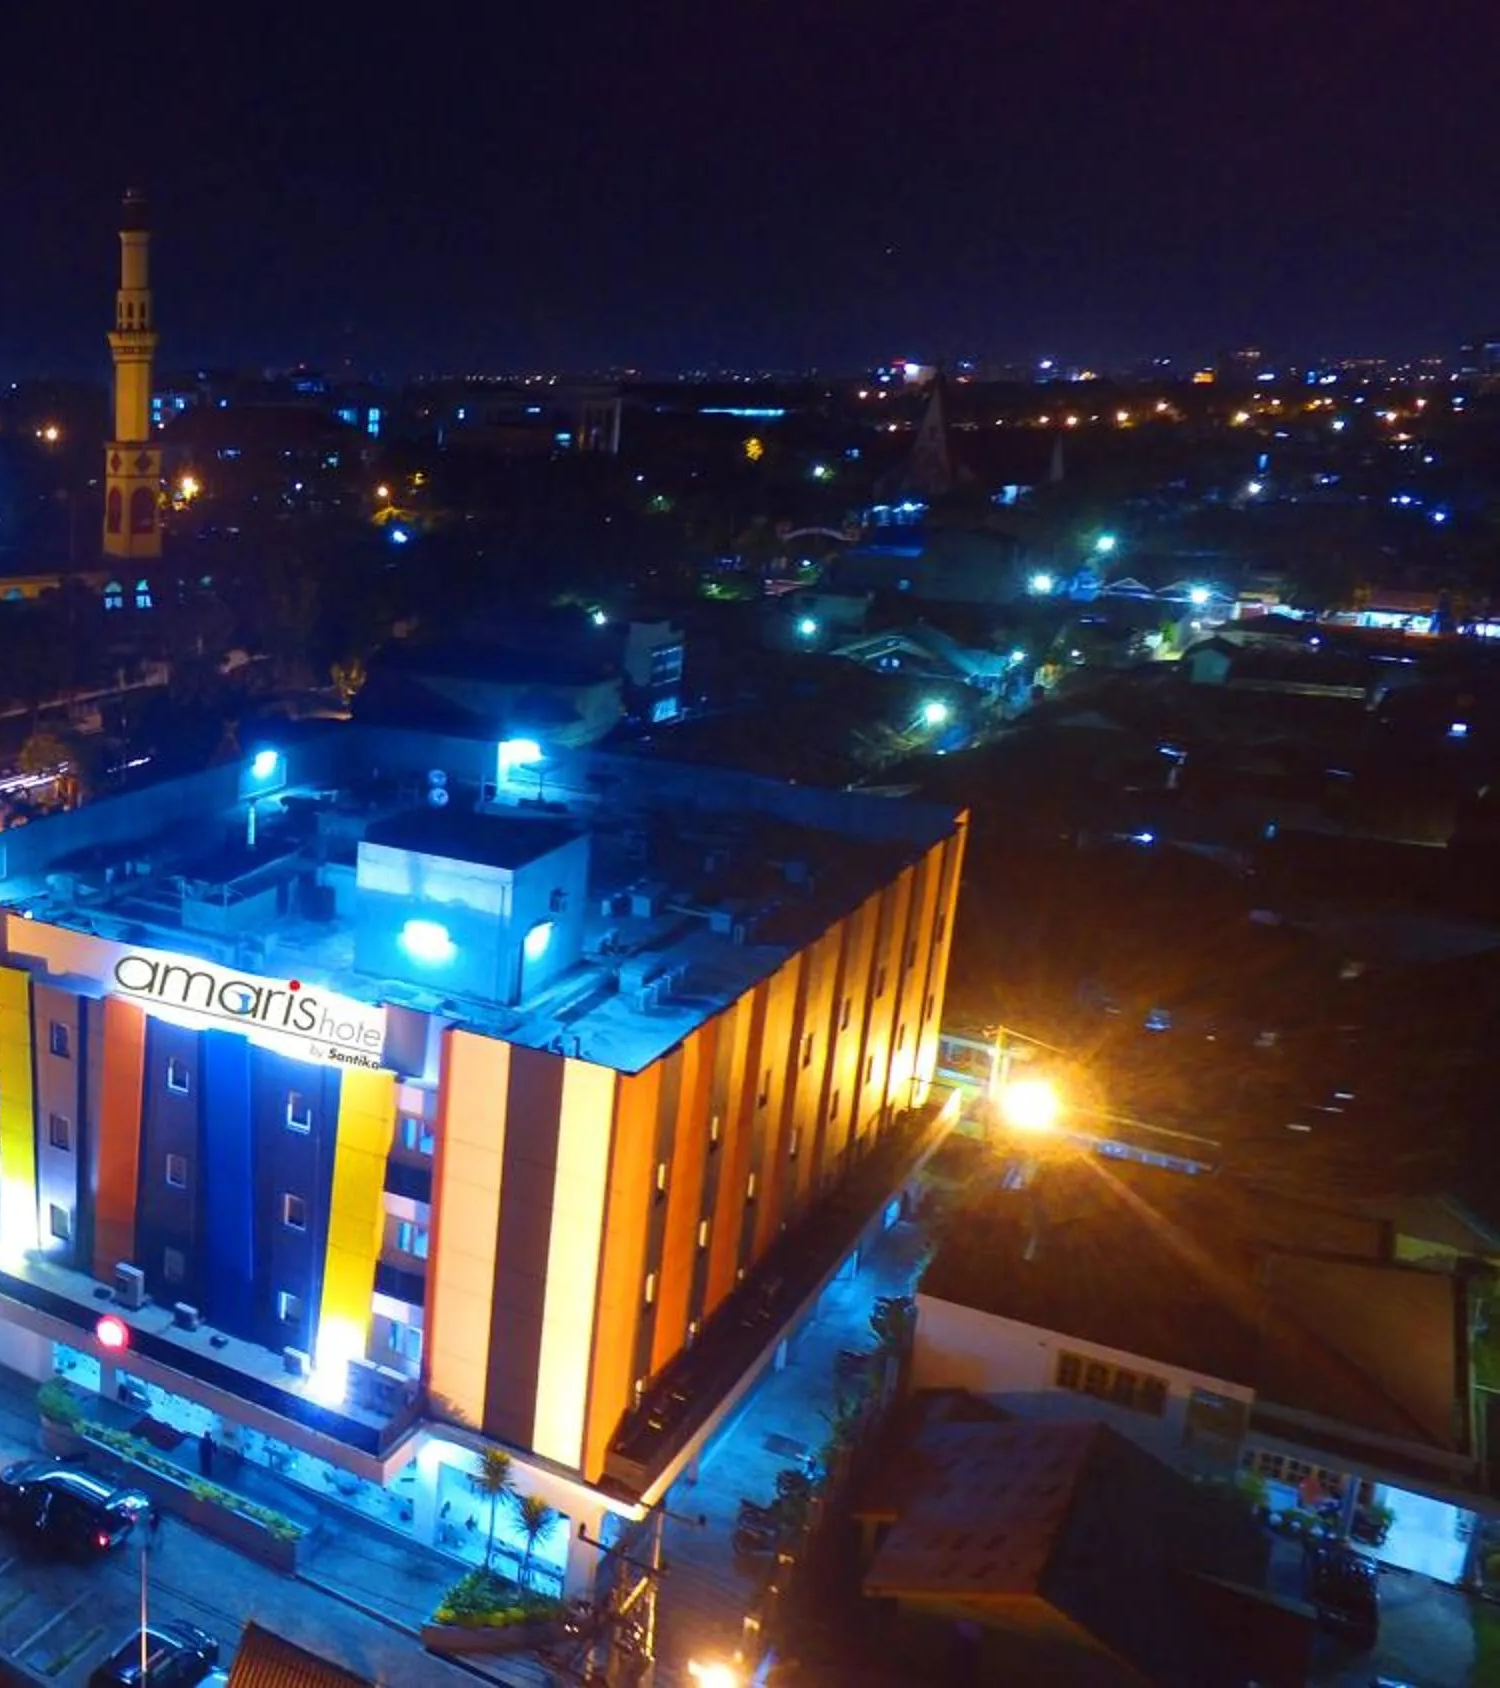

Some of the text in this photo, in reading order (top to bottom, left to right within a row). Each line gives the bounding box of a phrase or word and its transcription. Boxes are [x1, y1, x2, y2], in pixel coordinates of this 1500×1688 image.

[114, 955, 382, 1047] amaris hote
[328, 1047, 380, 1070] Santika
